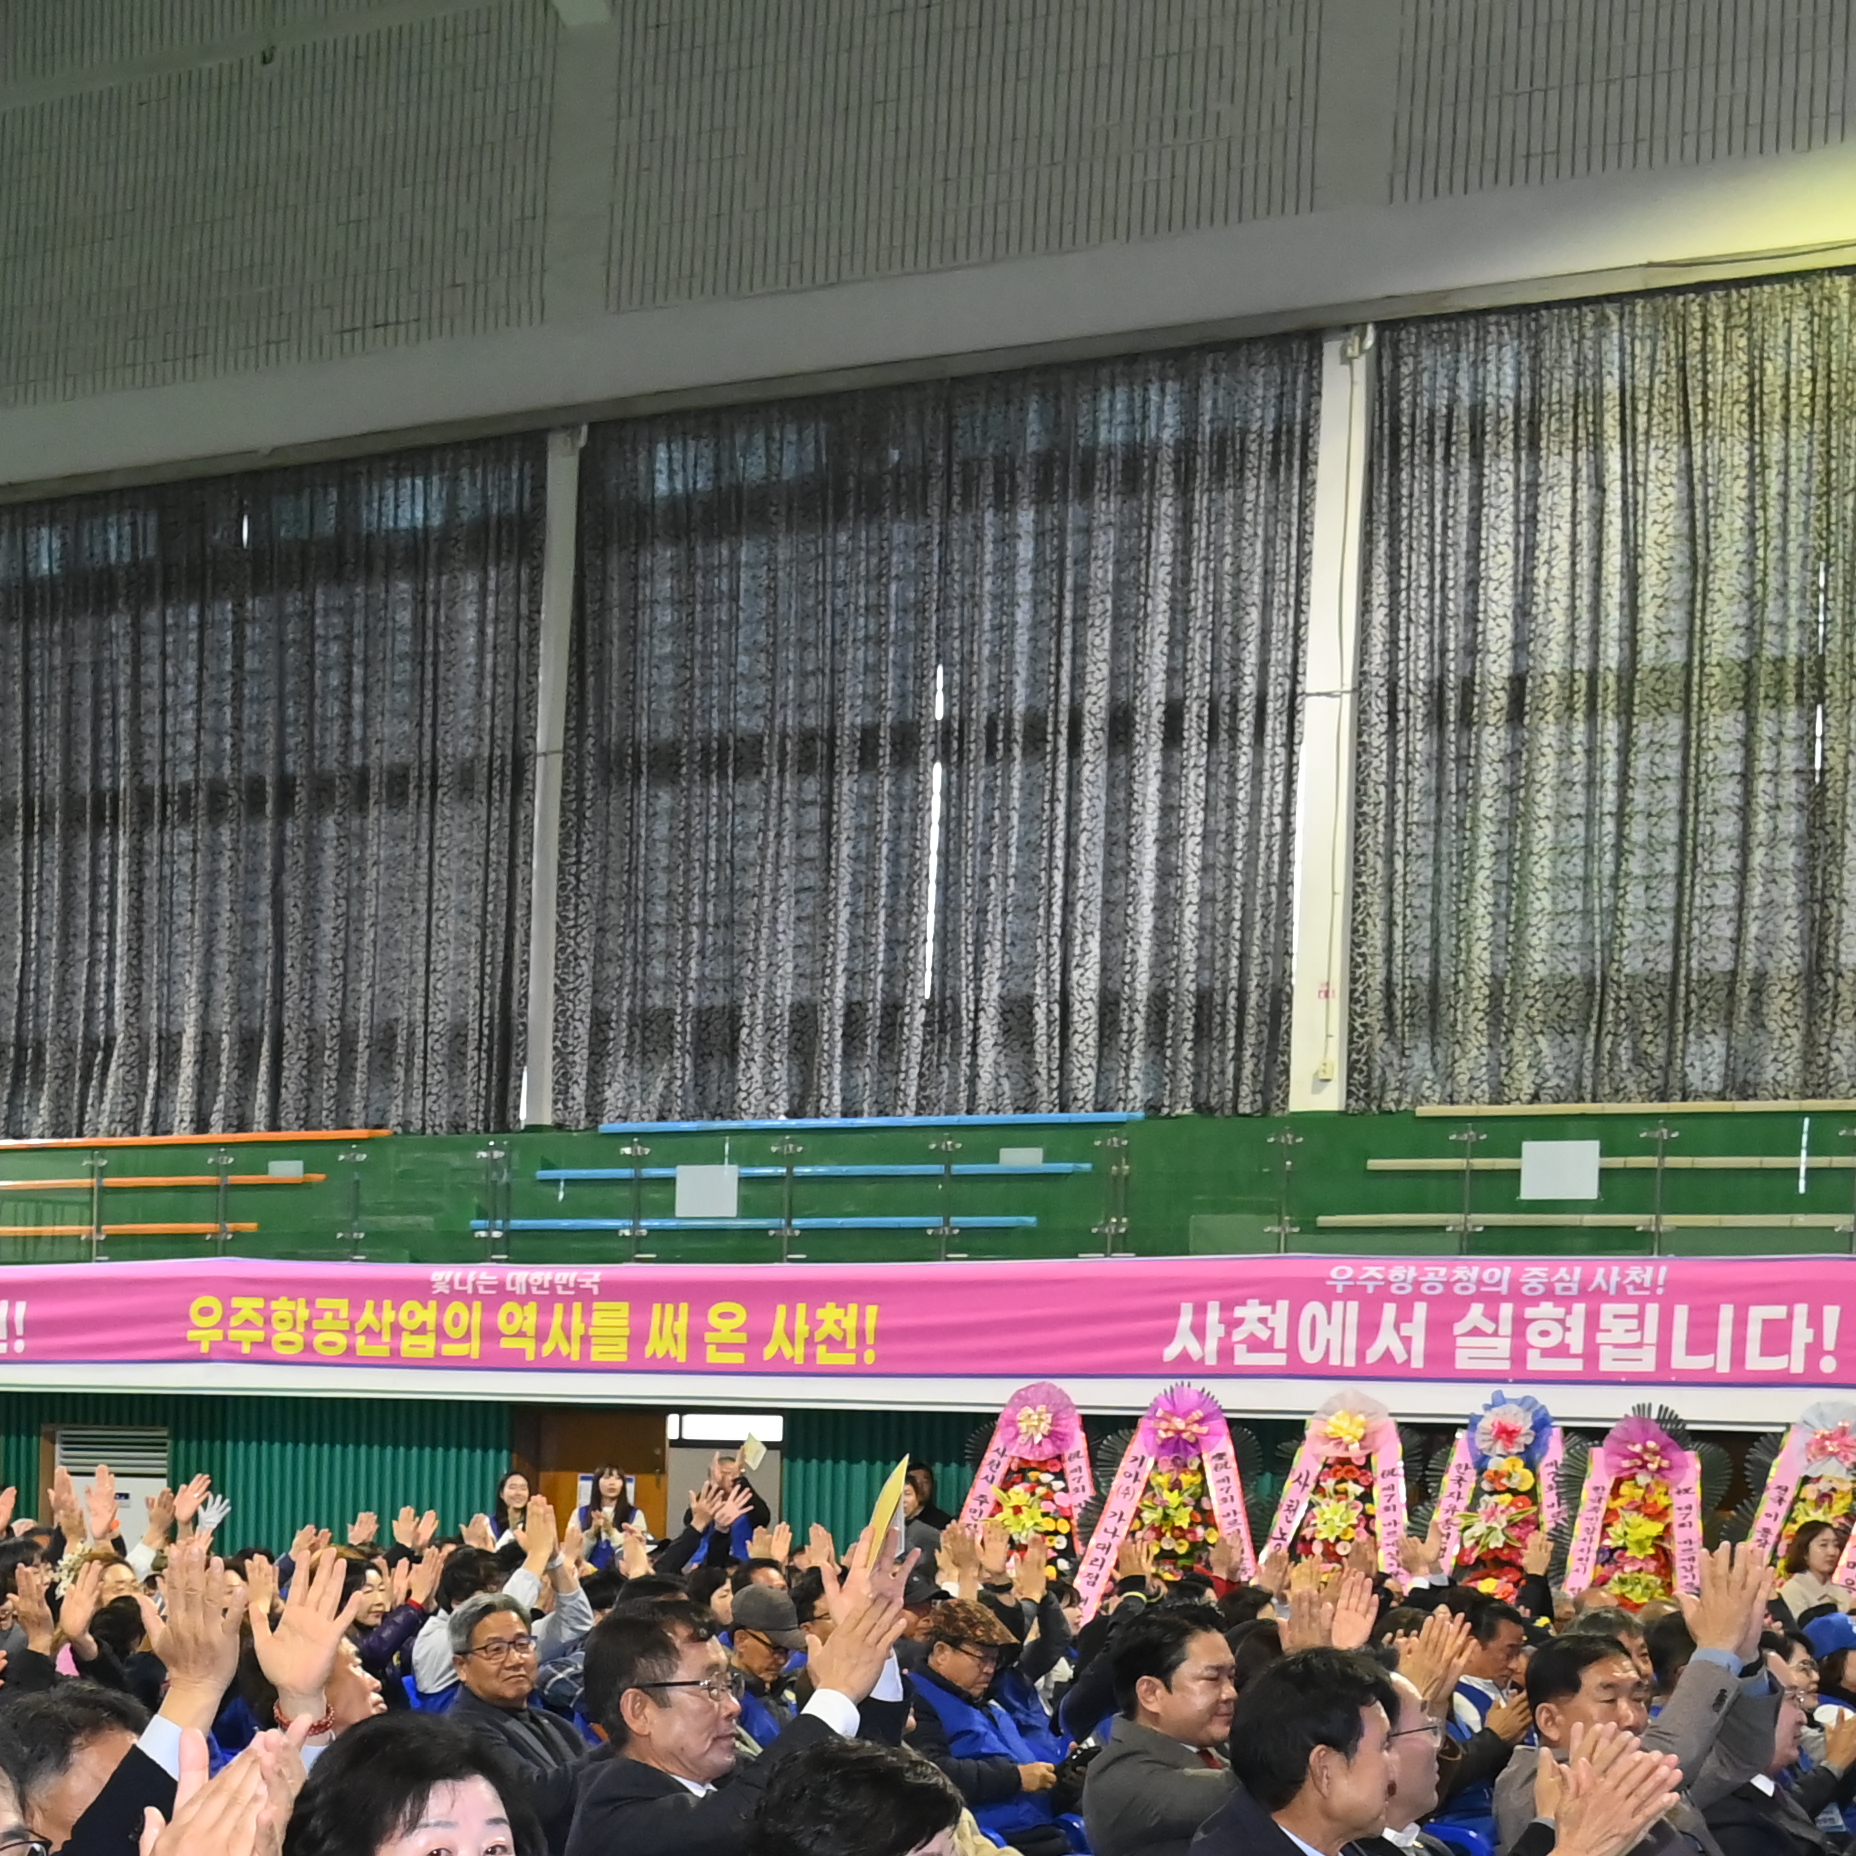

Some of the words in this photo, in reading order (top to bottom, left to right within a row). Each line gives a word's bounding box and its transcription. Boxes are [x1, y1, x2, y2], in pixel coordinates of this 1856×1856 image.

[431, 1270, 498, 1295] 빛나는
[505, 1270, 602, 1295] 대한민국
[1325, 1265, 1510, 1296] 우주항공청의
[1519, 1265, 1580, 1297] 중심
[1586, 1265, 1668, 1297] 사천!
[187, 1295, 482, 1359] 우주항공산업의
[496, 1300, 630, 1362] 역사를
[644, 1301, 689, 1363] 써
[703, 1300, 748, 1365] 온
[762, 1301, 879, 1366] 사천!
[1162, 1298, 1428, 1370] 사천에서
[1451, 1300, 1841, 1374] 실현됩니다!
